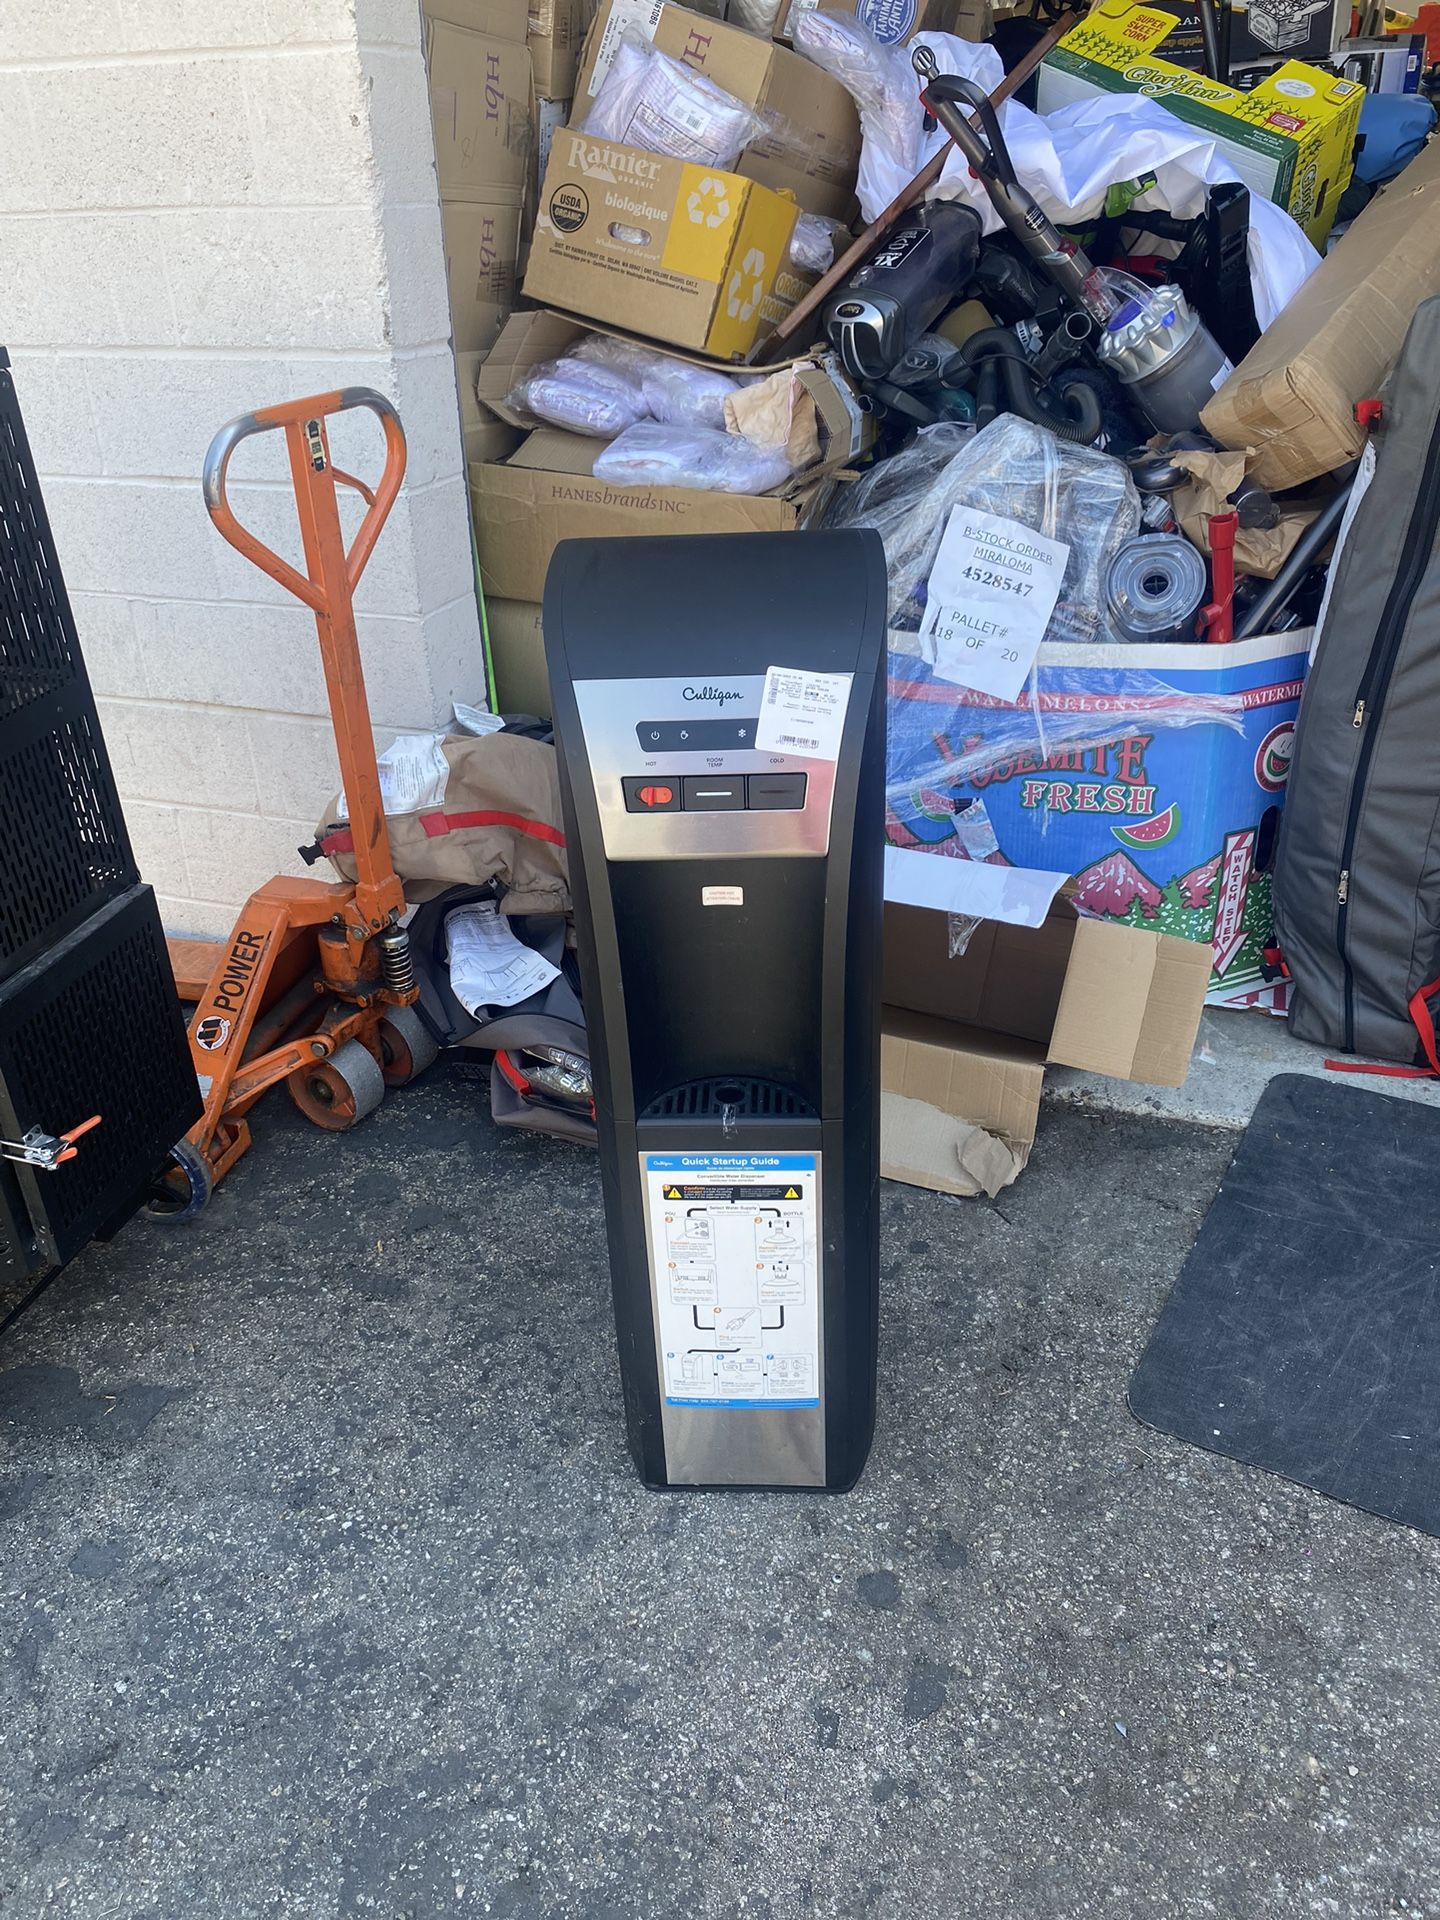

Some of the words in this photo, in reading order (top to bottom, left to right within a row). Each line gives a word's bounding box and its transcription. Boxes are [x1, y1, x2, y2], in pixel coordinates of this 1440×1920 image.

[1121, 29, 1150, 42] CORN
[1126, 21, 1161, 37] SWEET
[1135, 14, 1167, 29] SUPER
[567, 137, 662, 181] Rainier
[618, 174, 655, 190] ORGANIC
[554, 207, 582, 223] ORGANIC
[559, 193, 581, 210] USDA
[604, 191, 669, 222] biologique
[874, 255, 900, 267] XL
[963, 526, 1013, 549] B-STOCK
[1016, 542, 1053, 564] ORDER
[973, 546, 1033, 574] MIRALOMA
[961, 565, 1034, 597] 4528547
[937, 626, 954, 641] 18
[965, 636, 986, 651] OF
[1000, 648, 1019, 663] 20
[682, 686, 744, 707] Culligan
[1023, 779, 1156, 815] FRESH
[1227, 854, 1243, 902] WATCH
[1221, 907, 1234, 945] STEP
[212, 930, 265, 1013] POWER
[681, 1157, 710, 1167] Quick
[712, 1157, 748, 1168] Startup
[750, 1157, 780, 1166] Guide
